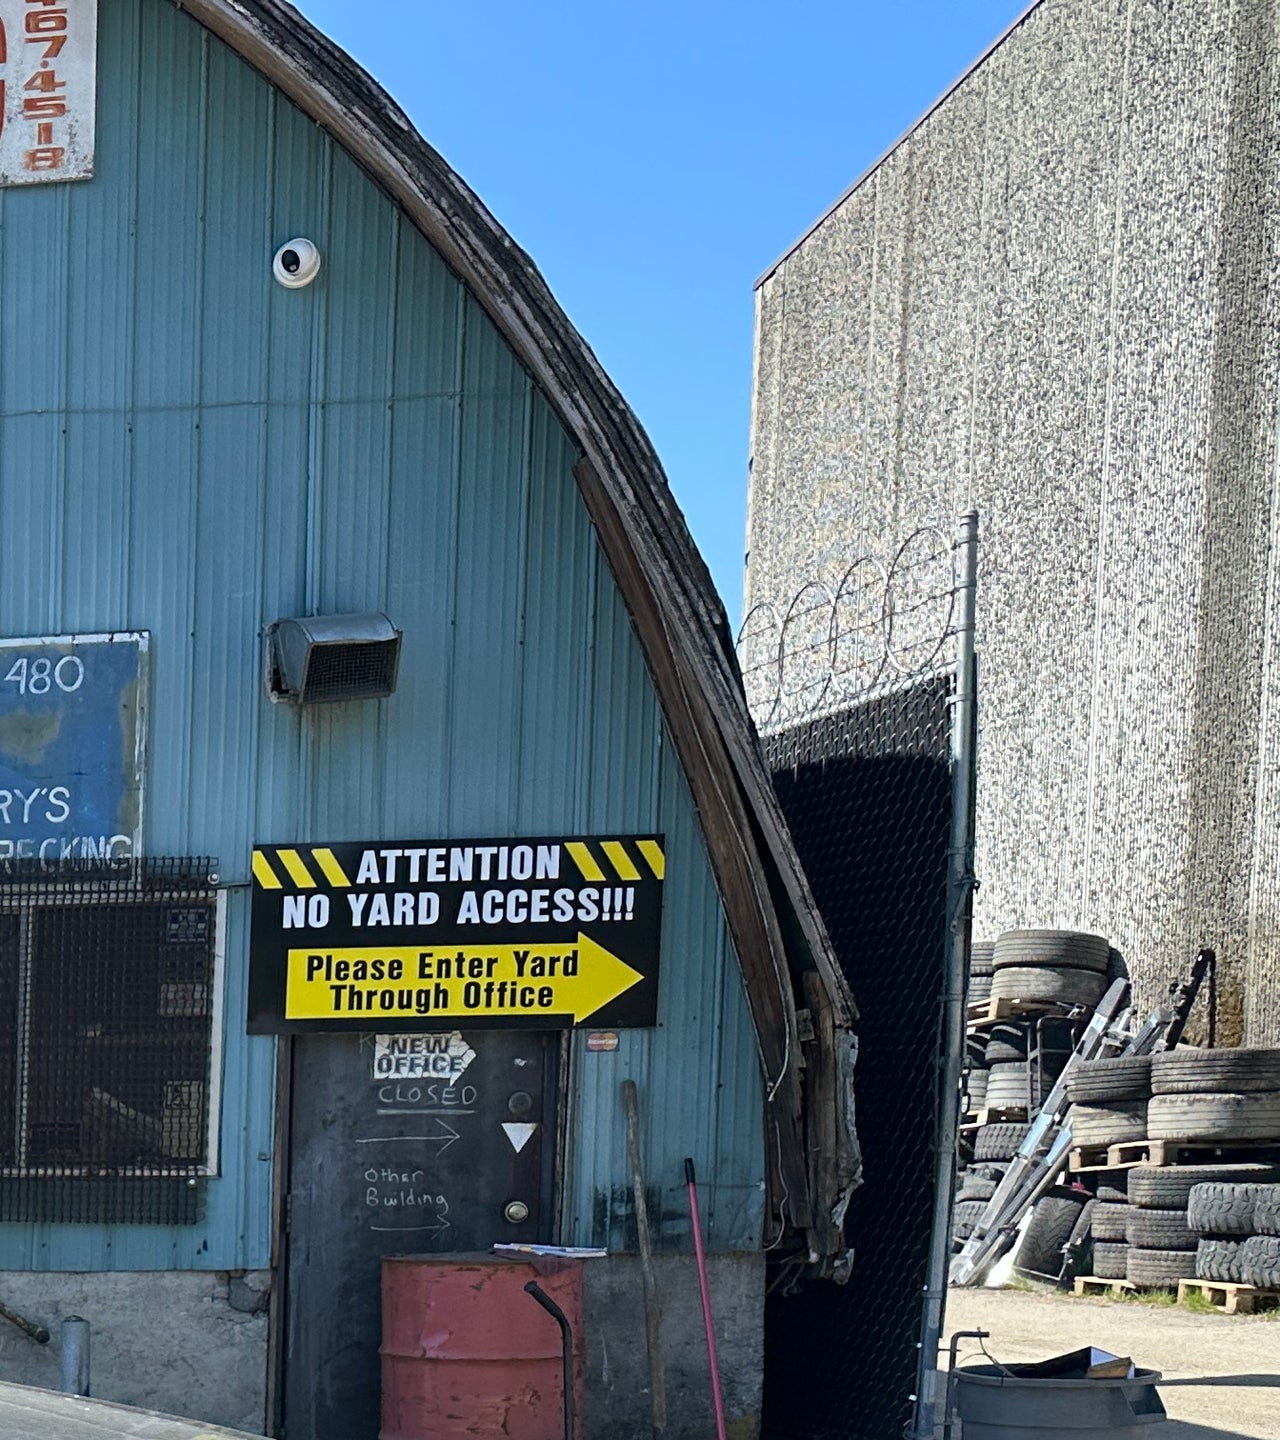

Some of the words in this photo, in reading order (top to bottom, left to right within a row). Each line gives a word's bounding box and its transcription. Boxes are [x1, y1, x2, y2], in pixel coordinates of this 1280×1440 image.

[355, 842, 561, 884] ATTENTION
[282, 893, 330, 929] NO
[346, 890, 440, 927] YARD
[456, 886, 635, 925] ACCESS!!!
[306, 953, 403, 982] Please
[418, 951, 498, 979] Enter
[513, 948, 579, 978] Yard
[329, 983, 450, 1014] Through
[463, 980, 554, 1009] Office
[389, 1037, 450, 1055] NEW
[376, 1053, 465, 1074] OFFICE
[378, 1084, 477, 1105] CLOSED
